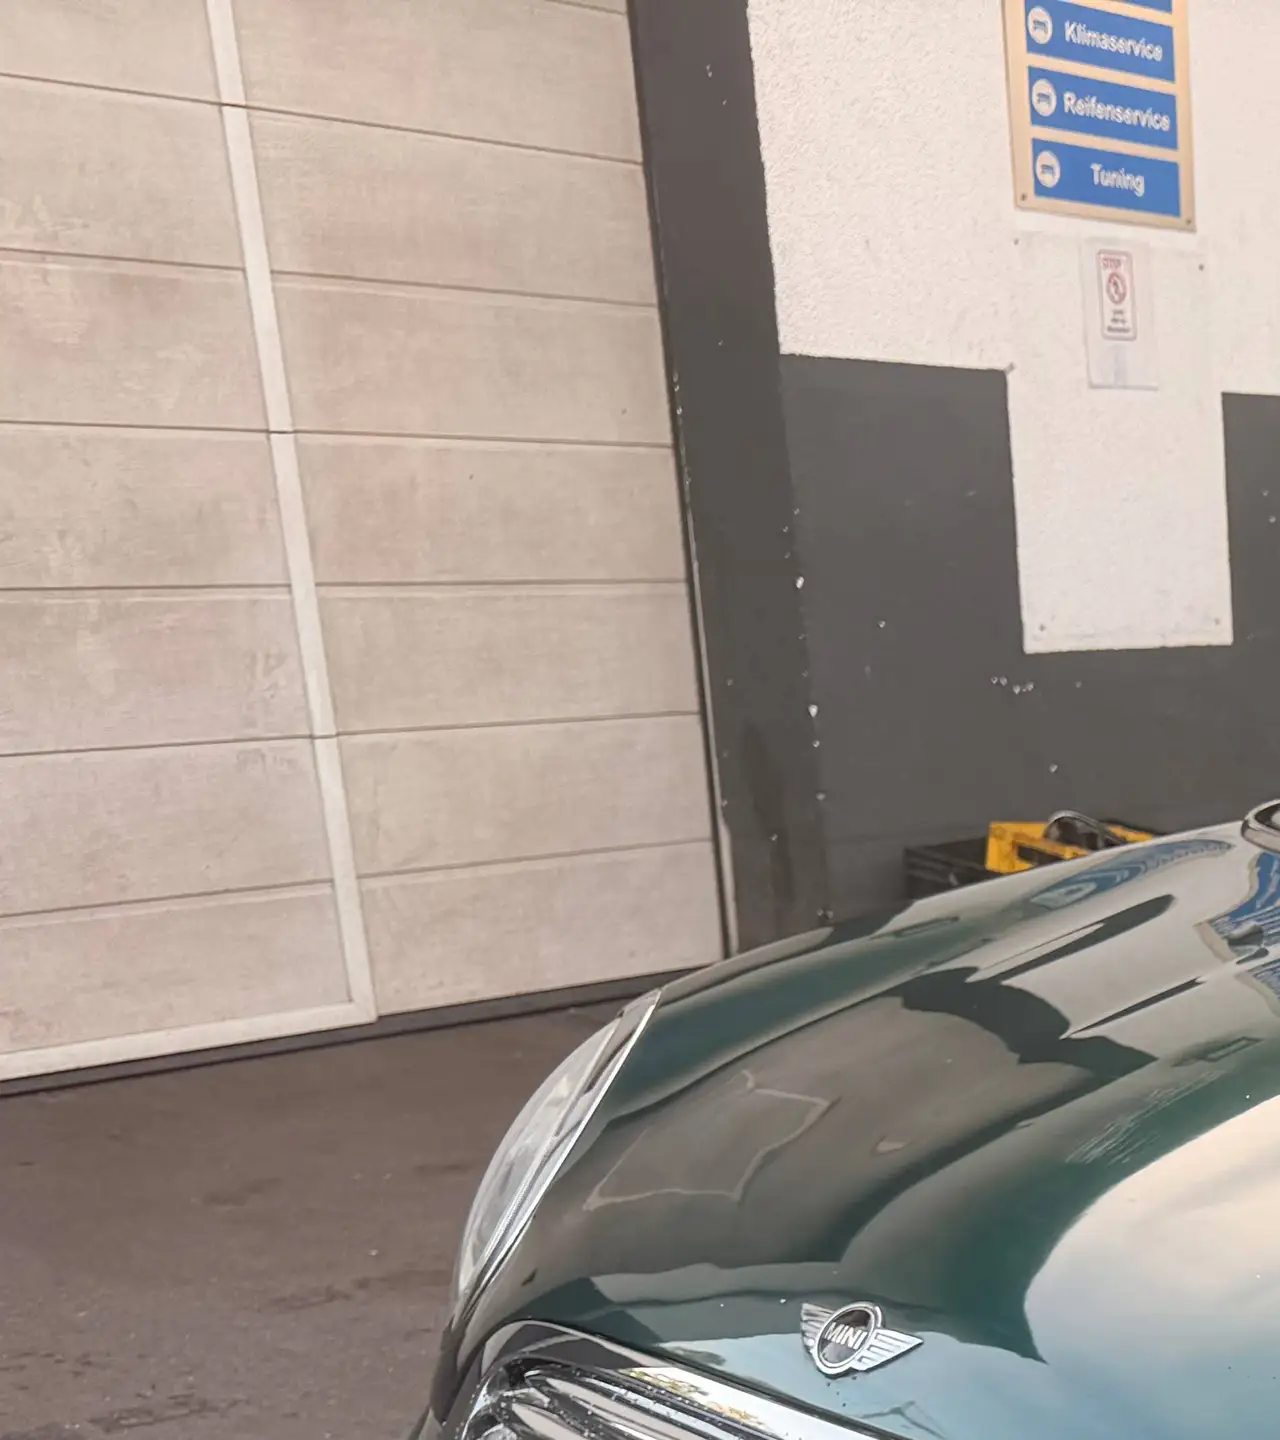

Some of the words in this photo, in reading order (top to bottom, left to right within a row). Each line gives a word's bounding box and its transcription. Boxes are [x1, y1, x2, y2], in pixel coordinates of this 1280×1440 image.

[1064, 20, 1163, 62] Klimaservice
[1063, 91, 1170, 132] Reifenservice
[1090, 162, 1145, 197] Tuning
[825, 1322, 867, 1350] MINI
